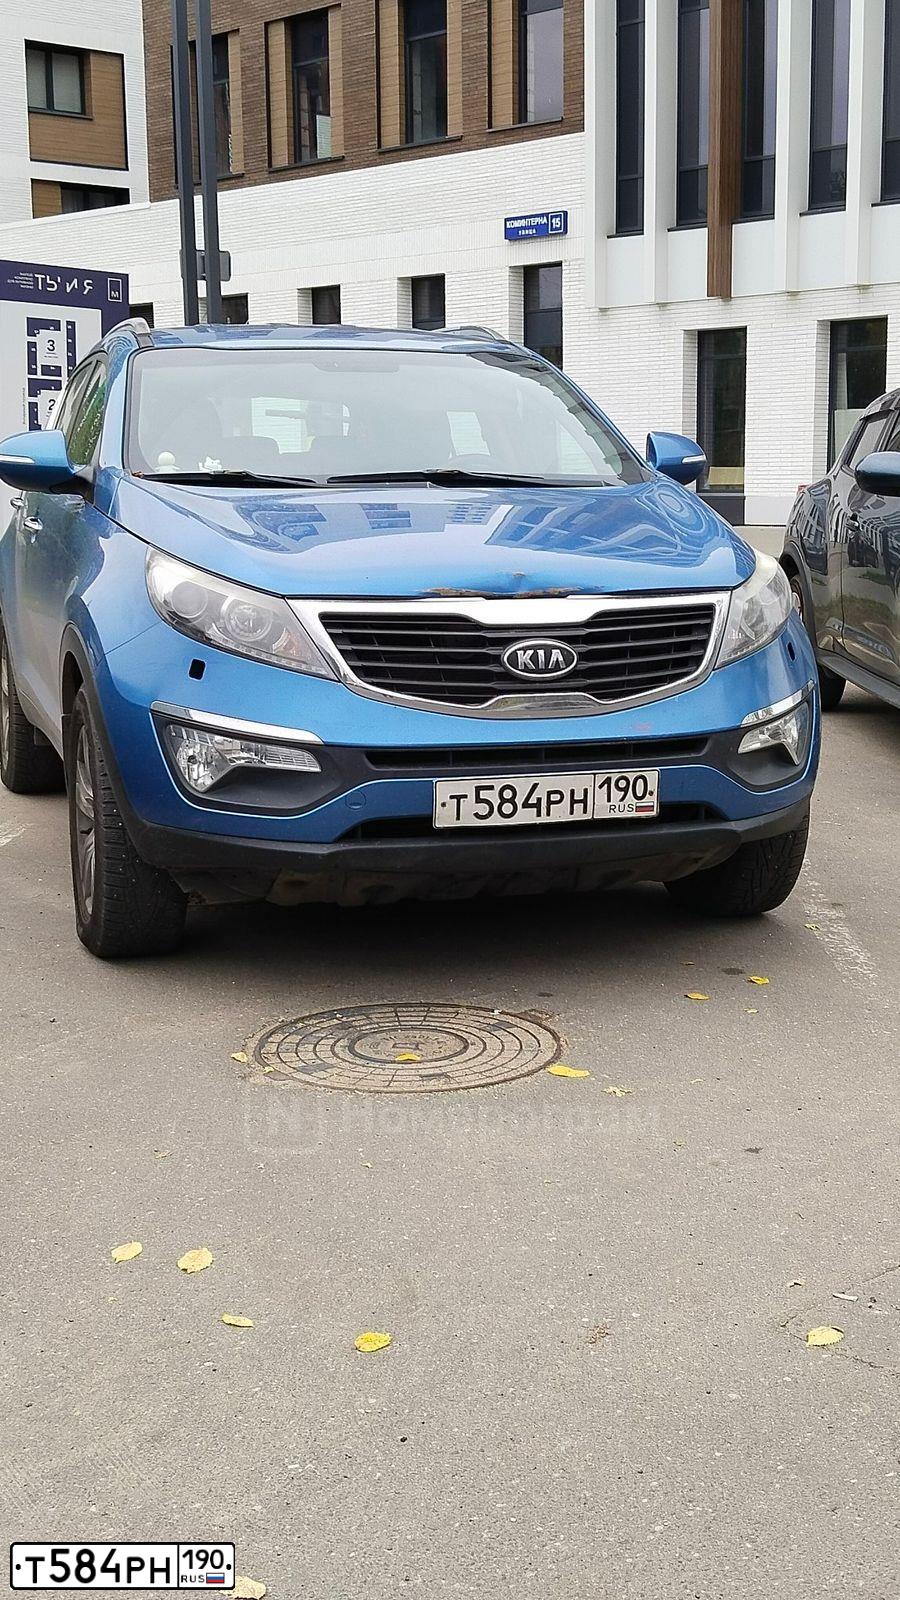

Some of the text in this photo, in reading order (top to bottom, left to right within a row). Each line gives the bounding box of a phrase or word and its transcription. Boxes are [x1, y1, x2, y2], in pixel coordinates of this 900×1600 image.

[551, 217, 561, 229] 15
[46, 339, 56, 352] 3
[48, 398, 56, 411] 2
[516, 649, 567, 670] KIA
[449, 774, 648, 821] Т584РН 190
[608, 803, 635, 814] RUS
